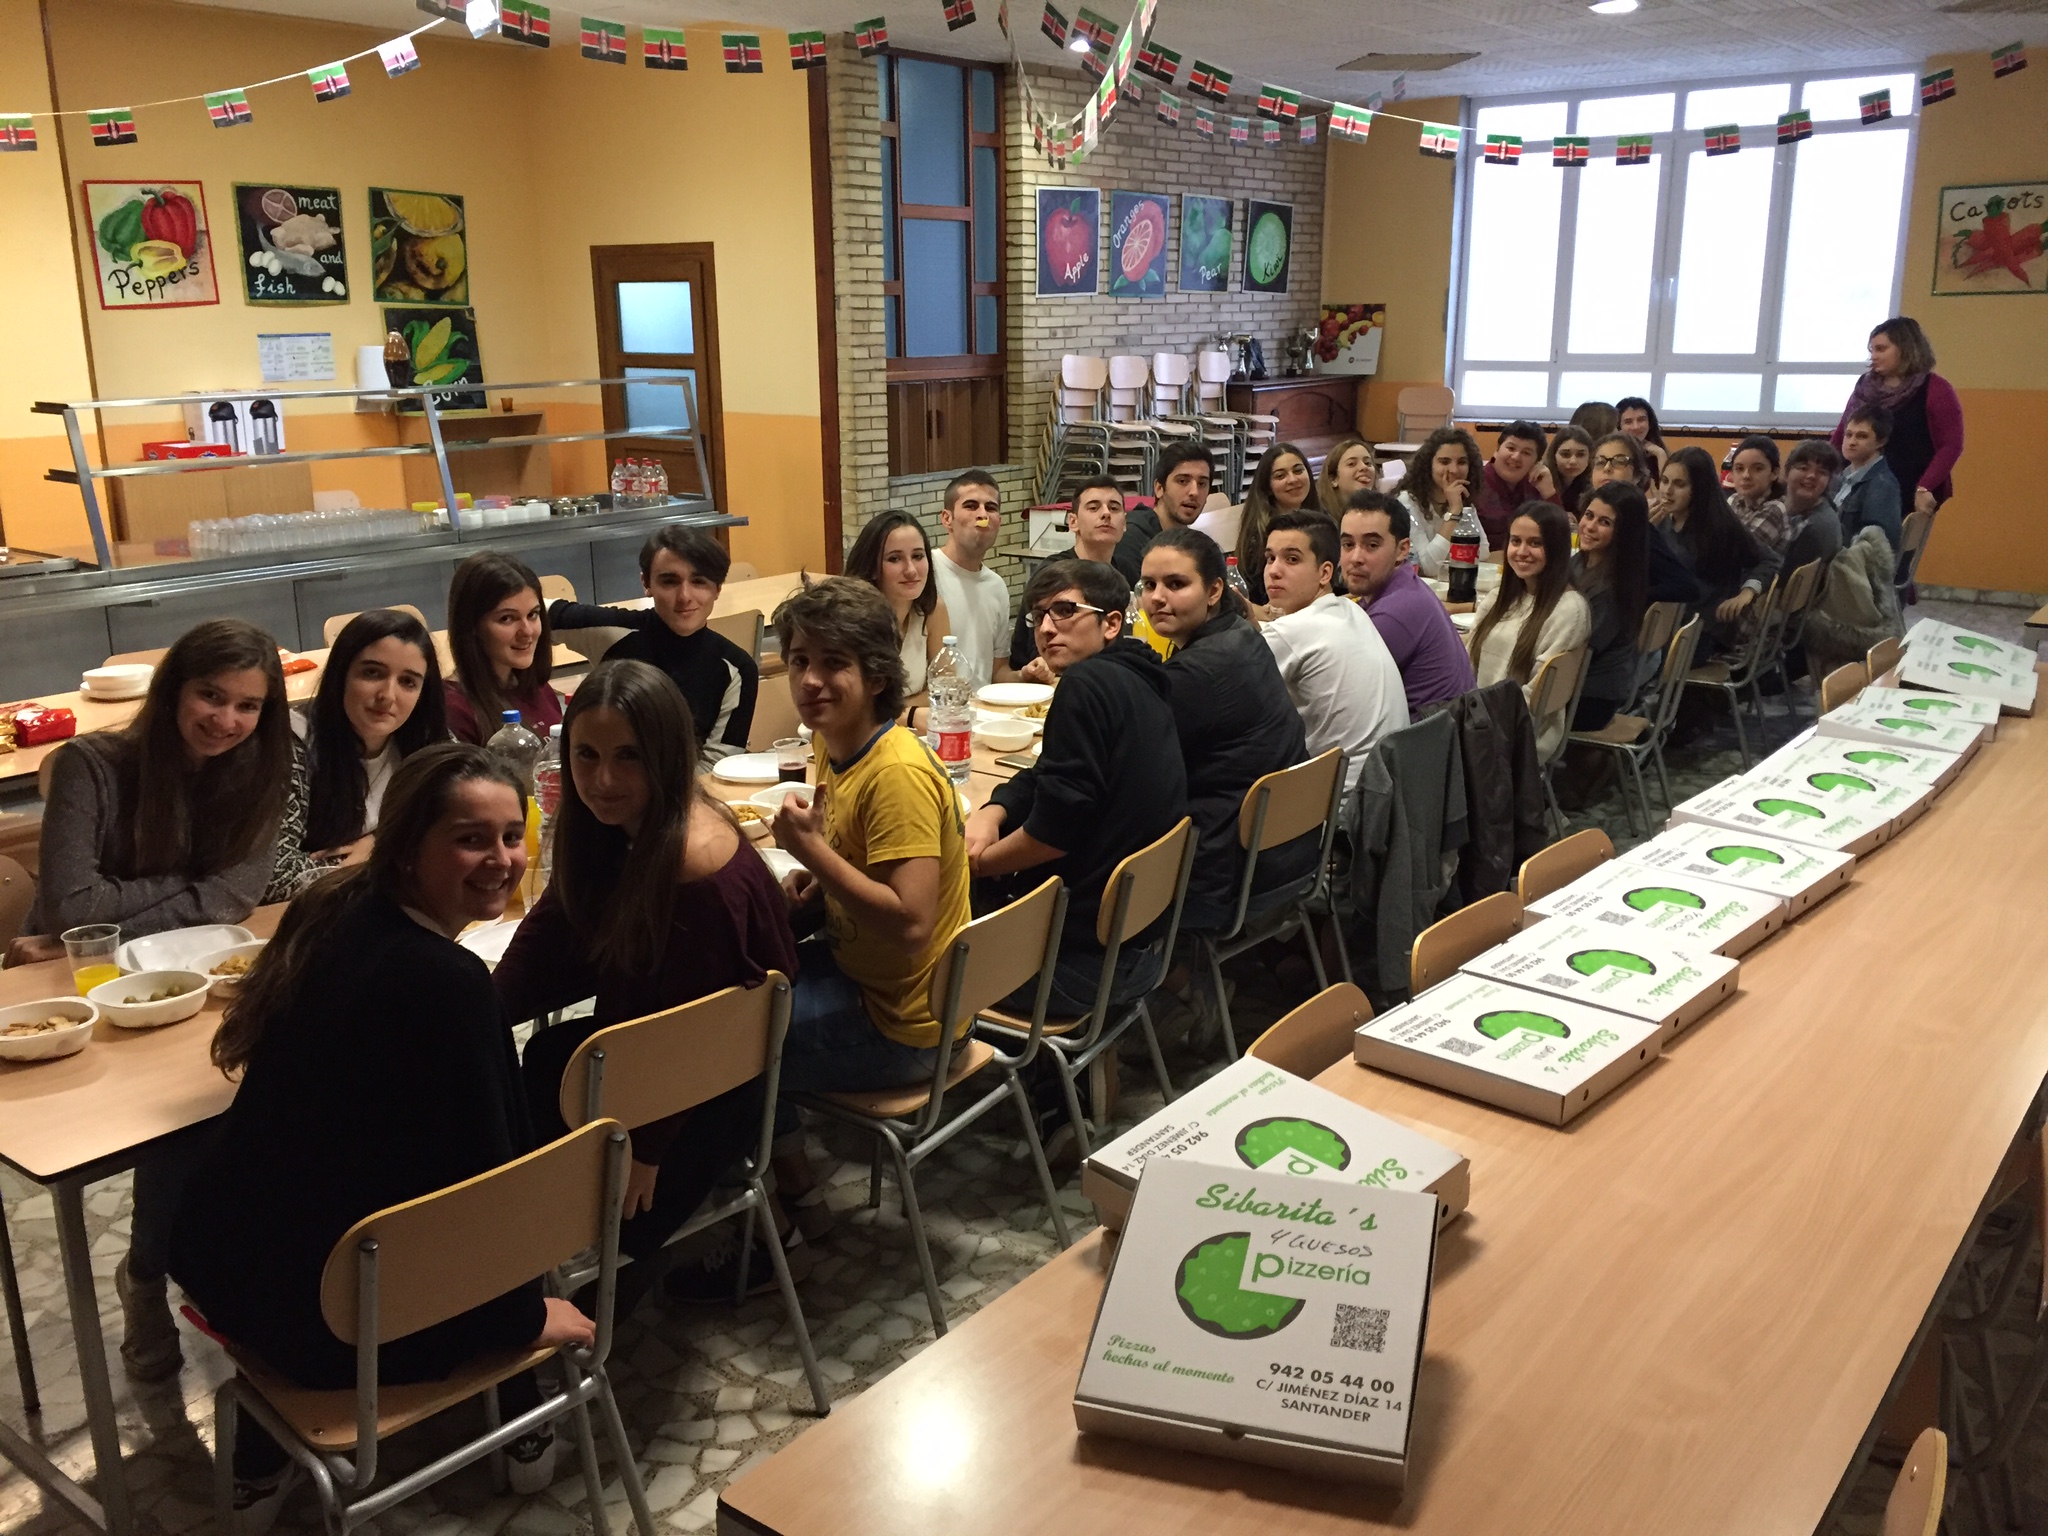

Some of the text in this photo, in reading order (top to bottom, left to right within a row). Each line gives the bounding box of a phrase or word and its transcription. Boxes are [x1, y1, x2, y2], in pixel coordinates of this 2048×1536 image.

[298, 193, 338, 210] meat
[1112, 200, 1144, 249] Oranges
[320, 250, 343, 264] and
[1064, 252, 1089, 283] Apple
[1262, 254, 1283, 281] Kiwi
[108, 262, 200, 301] Peppers
[254, 273, 296, 297] fish
[1199, 263, 1222, 284] Pear
[1170, 1131, 1209, 1156] 942 05
[1270, 1229, 1292, 1245] 4
[1251, 1252, 1371, 1286] pizzería
[1107, 1334, 1156, 1354] Pizzas
[1102, 1349, 1235, 1384] hechas al momento
[1270, 1363, 1394, 1394] 942 05 44 00
[1256, 1379, 1402, 1411] C/ JIMÉNEZ DÍAZ 14
[1281, 1398, 1371, 1422] SANTANDER
